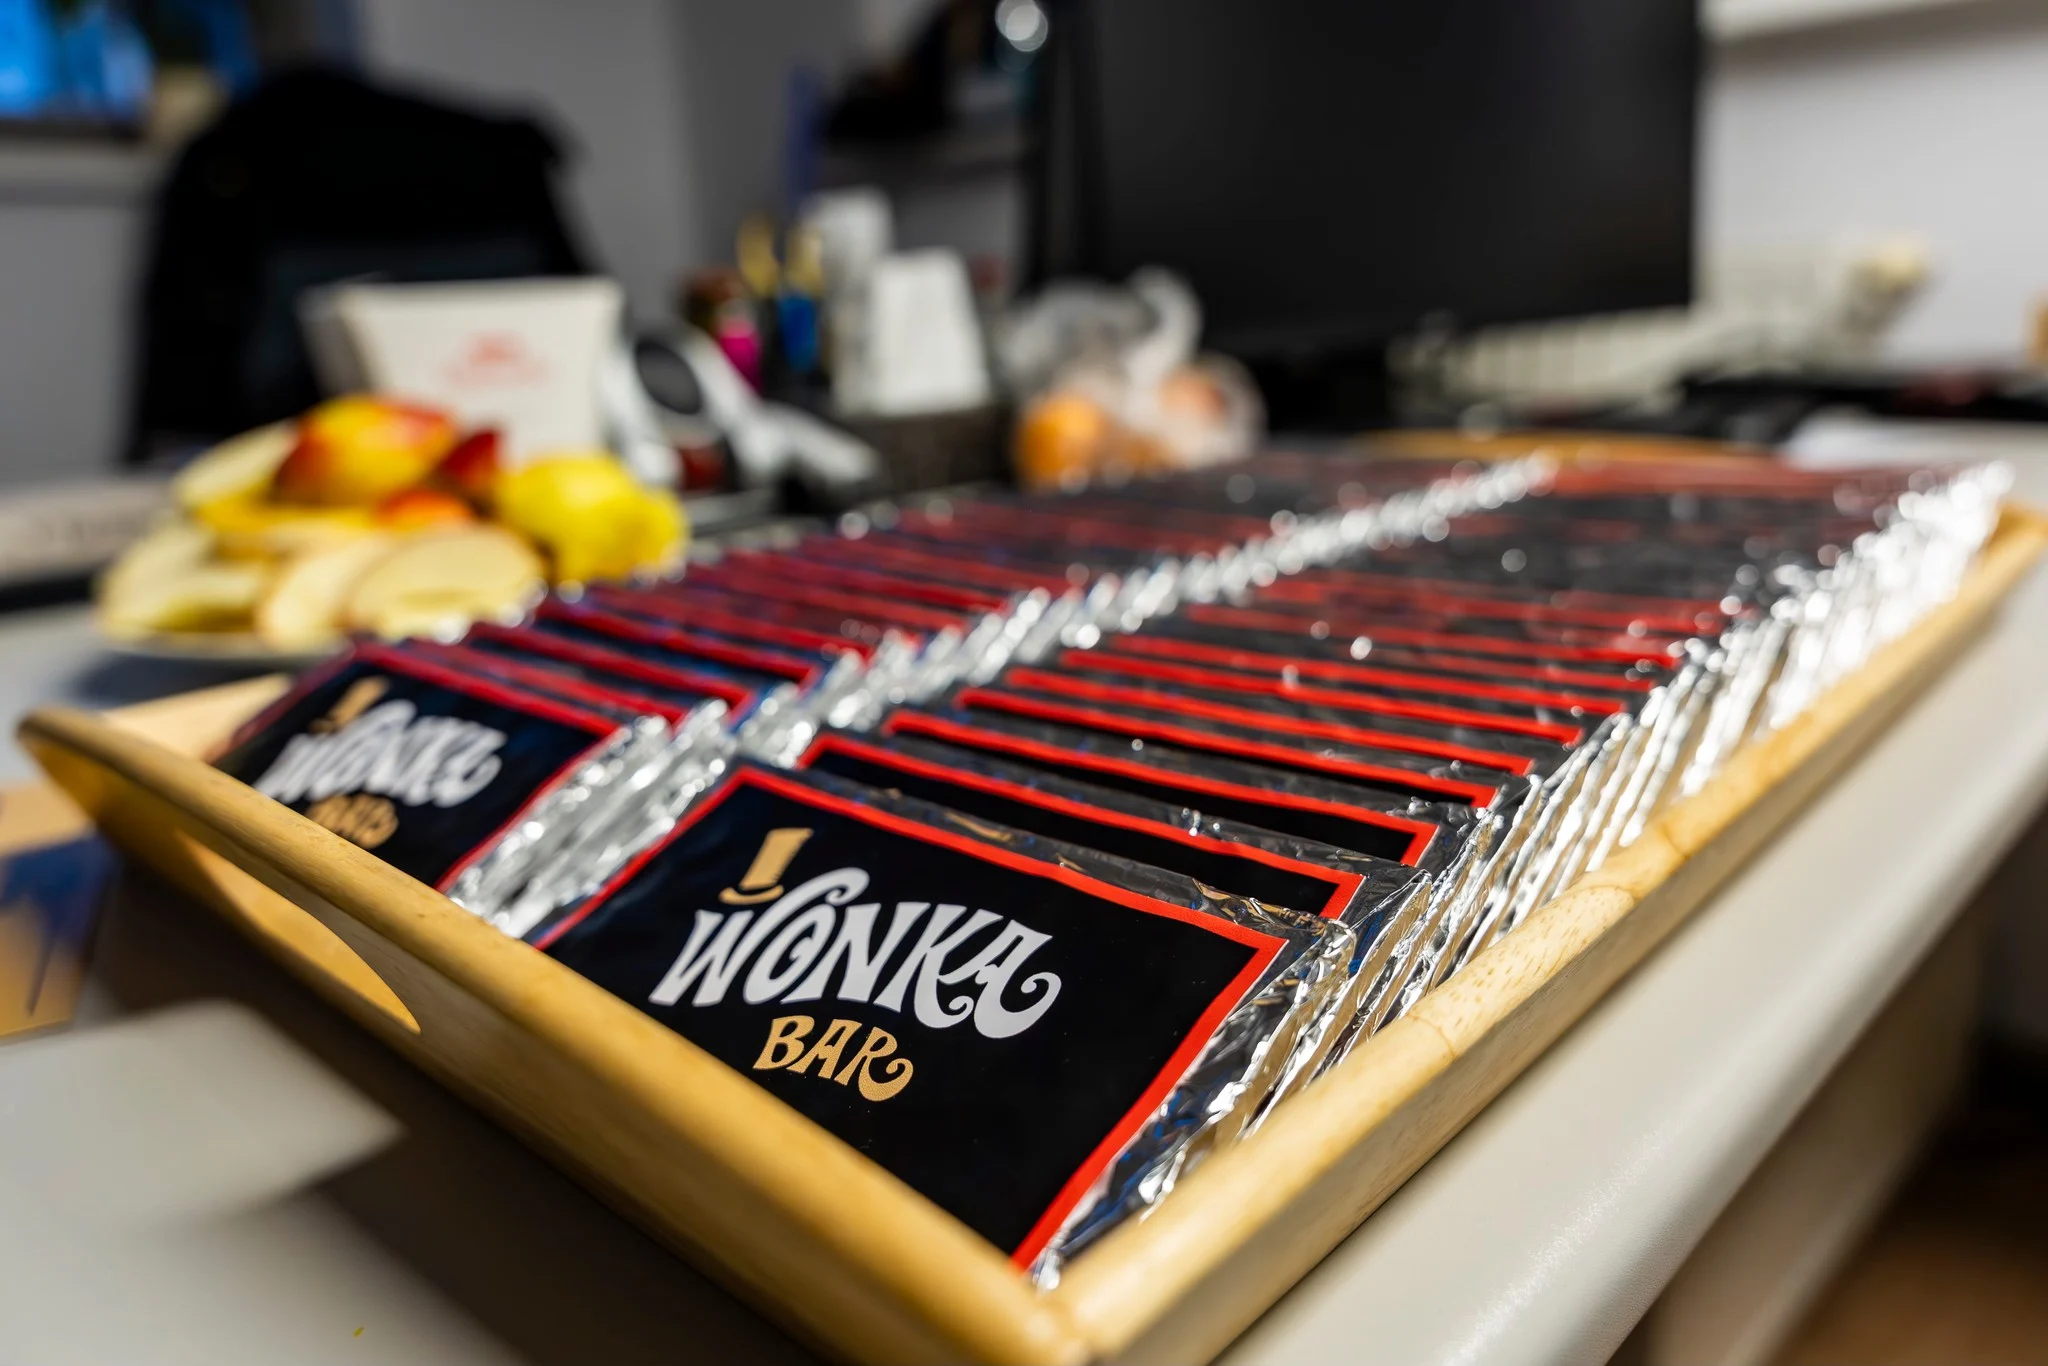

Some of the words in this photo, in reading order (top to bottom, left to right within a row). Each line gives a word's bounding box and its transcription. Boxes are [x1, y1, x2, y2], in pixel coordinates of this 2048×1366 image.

[255, 700, 506, 807] WONKA
[650, 868, 1062, 1039] WONKA
[753, 1015, 913, 1102] BAR
